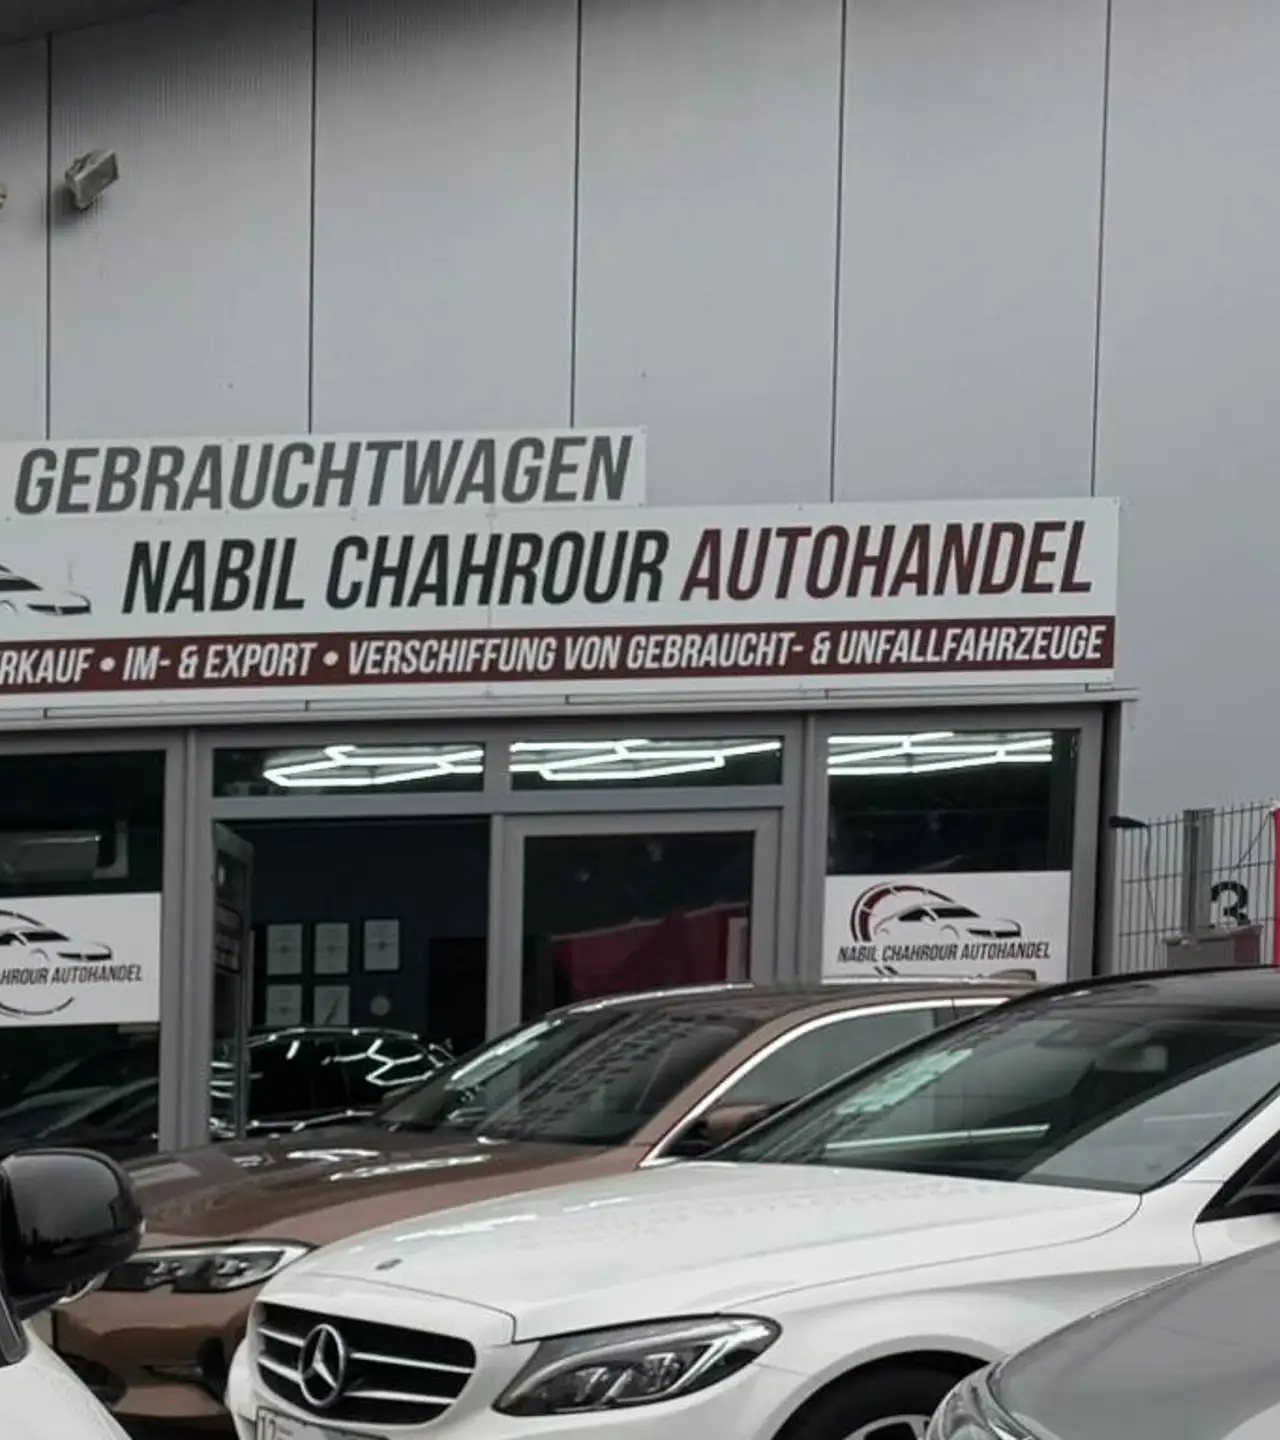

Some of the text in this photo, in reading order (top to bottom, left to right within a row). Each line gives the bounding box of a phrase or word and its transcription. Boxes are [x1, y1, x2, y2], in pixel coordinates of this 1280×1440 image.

[14, 435, 634, 515] GEBRAUCHTWAGEN
[121, 520, 1094, 614] NABIL CHAHROUR AUTOHANDEL
[122, 646, 171, 682] IM-
[177, 644, 199, 680] &
[203, 641, 318, 679] EXPORT
[347, 636, 556, 676] VERSCHIFFUNG
[563, 634, 622, 672] VON
[625, 630, 804, 670] GEBRAUCHT-
[810, 630, 832, 666] &
[837, 623, 1108, 665] UNFALLFAHRZEUGE
[50, 963, 143, 985] AUTOHANDEL
[837, 941, 1051, 963] NABIL CHAHROUR AUTOHANDEL
